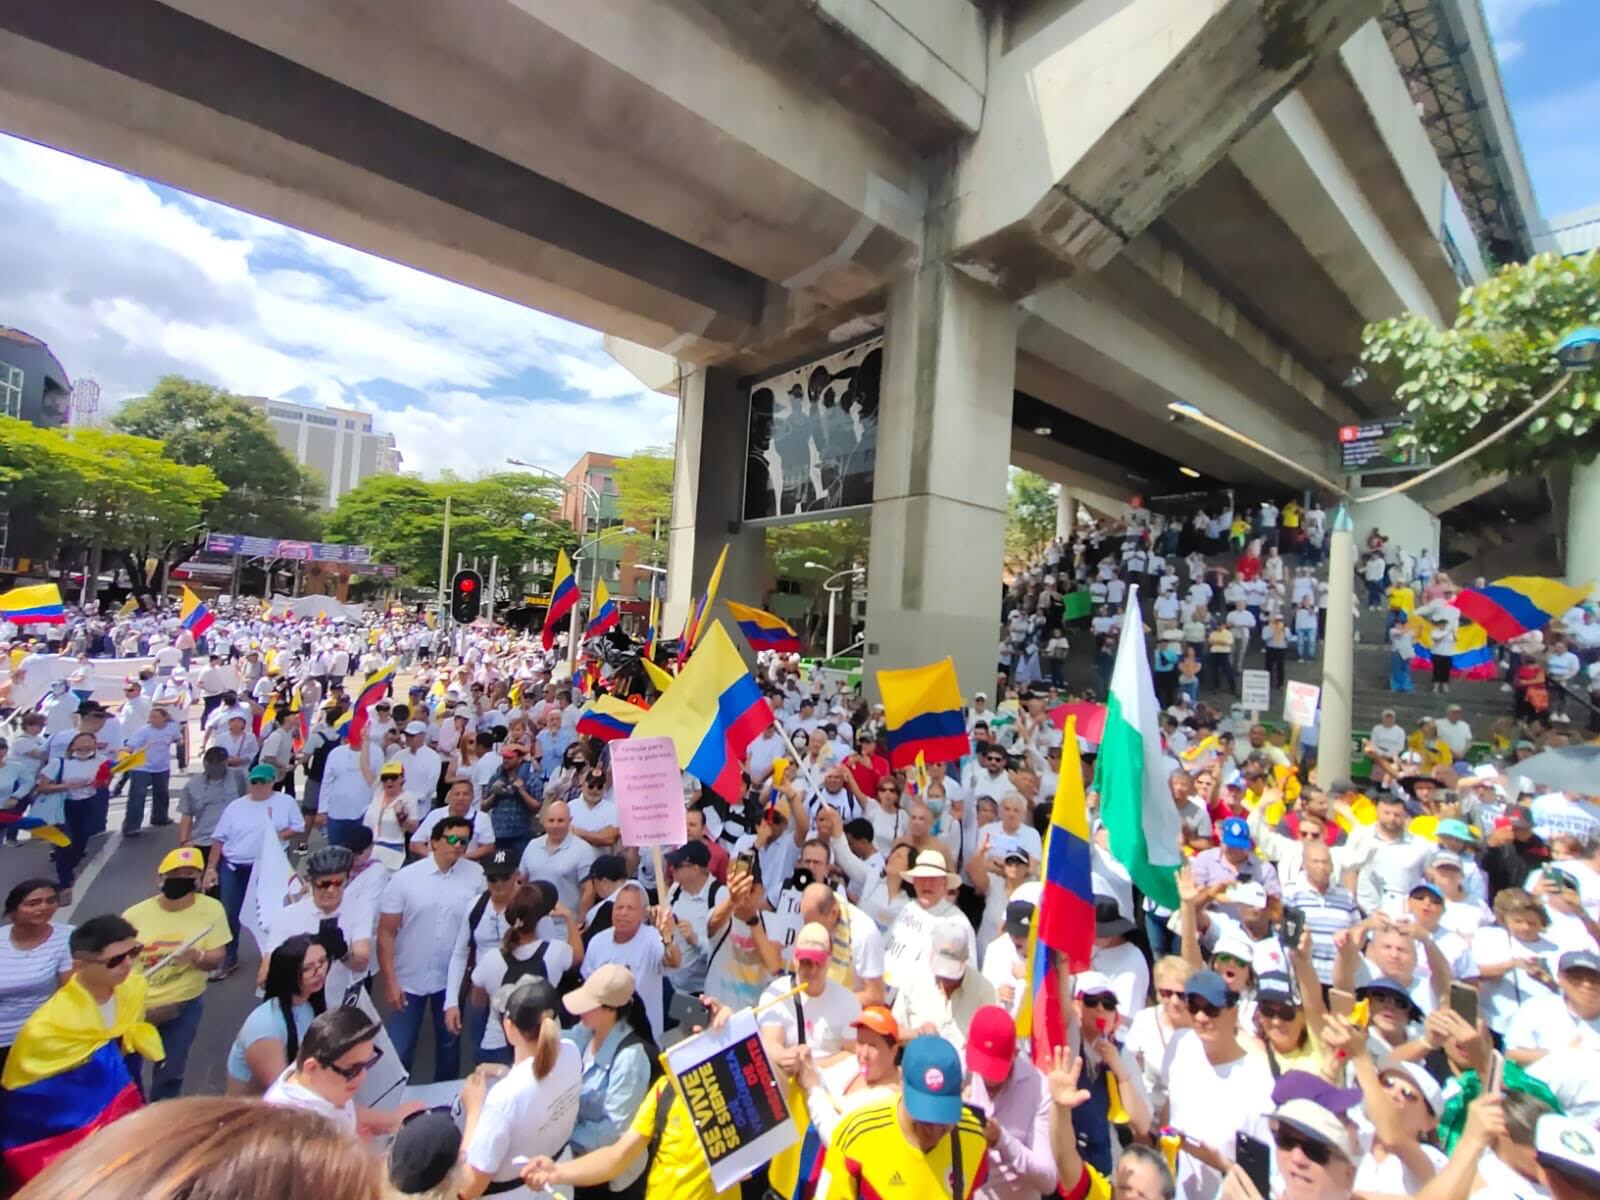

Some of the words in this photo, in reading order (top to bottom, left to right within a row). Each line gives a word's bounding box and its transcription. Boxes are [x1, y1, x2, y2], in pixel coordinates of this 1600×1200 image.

[699, 1062, 732, 1125] SIENTE
[743, 1063, 759, 1087] DE
[747, 1038, 786, 1121] PRESIDENTE
[682, 1070, 713, 1128] VIVE
[703, 1126, 727, 1159] SE
[722, 1123, 740, 1149] SE
